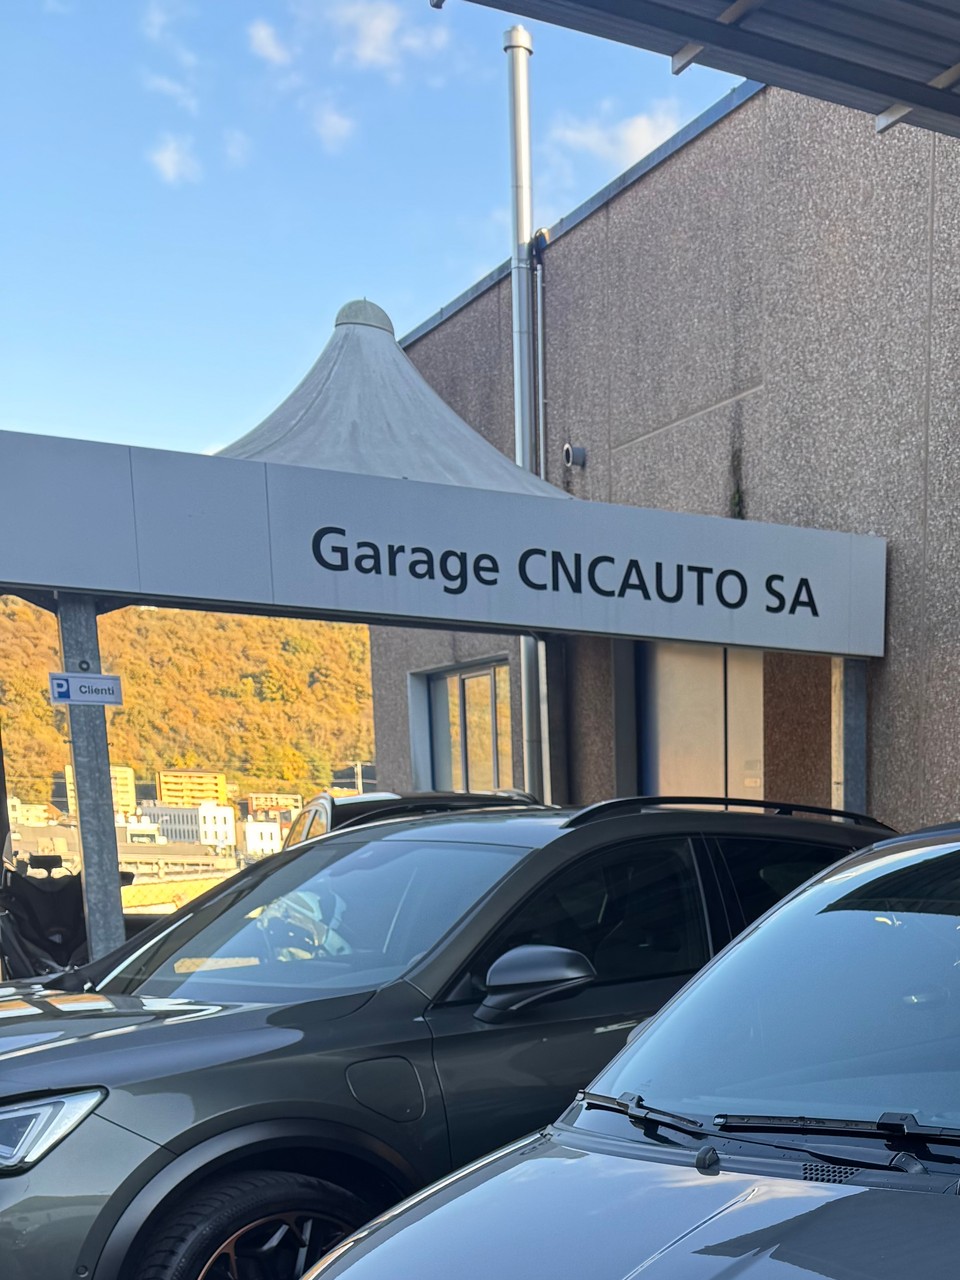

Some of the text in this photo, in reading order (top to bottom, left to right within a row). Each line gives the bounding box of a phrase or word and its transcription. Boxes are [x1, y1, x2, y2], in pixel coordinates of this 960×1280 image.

[311, 526, 820, 617] Garage CNCAUTO SA
[52, 679, 115, 698] P Clienti
